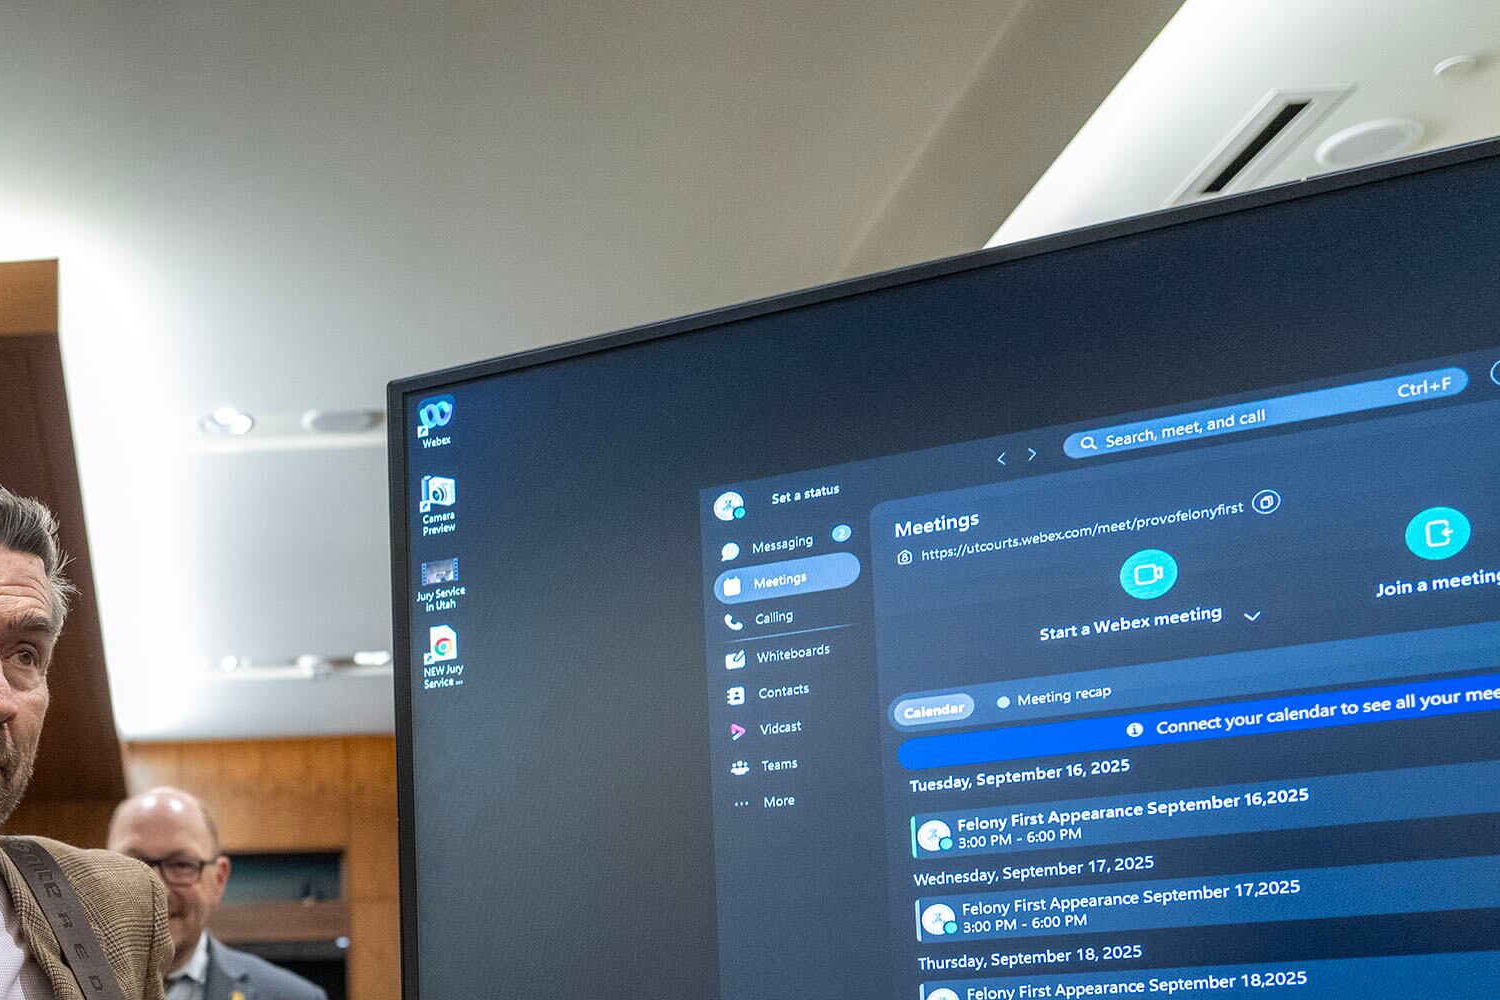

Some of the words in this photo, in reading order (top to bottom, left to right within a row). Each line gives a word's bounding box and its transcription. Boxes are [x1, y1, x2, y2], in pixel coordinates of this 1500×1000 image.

[1398, 376, 1451, 397] Ctrl+F
[1105, 428, 1157, 449] Search,
[1162, 421, 1203, 438] meet,
[1207, 414, 1235, 430] and
[1239, 409, 1265, 427] call
[423, 436, 451, 448] Webex
[772, 492, 791, 504] Set
[794, 492, 801, 501] a
[804, 486, 839, 499] status
[423, 512, 455, 524] Camera
[895, 514, 979, 537] Meetings
[423, 523, 455, 536] Preview
[838, 529, 845, 539] 2
[922, 501, 1244, 562] https://utcourts.webex.com/meet/provofelonyfirst
[753, 536, 813, 553] Messaging
[754, 572, 807, 589] Meetings
[1376, 580, 1412, 597] Join
[1417, 581, 1427, 591] a
[417, 592, 434, 602] Jury
[436, 586, 465, 599] Service
[426, 602, 434, 612] in
[436, 599, 456, 610] Utah
[756, 611, 793, 624] Calling
[1040, 626, 1077, 640] Start
[1081, 626, 1090, 635] a
[1093, 617, 1150, 633] Webex
[1154, 607, 1222, 626] meeting
[757, 644, 830, 663] Whiteboards
[424, 665, 445, 677] NEW
[446, 664, 464, 675] Jury
[424, 677, 454, 689] Service
[759, 684, 809, 699] Contacts
[1018, 691, 1071, 706] Meeting
[1076, 688, 1111, 699] recap
[904, 702, 965, 719] Calendar
[1157, 717, 1222, 734] Connect
[1225, 714, 1263, 731] your
[1267, 704, 1337, 722] calendar
[1340, 703, 1359, 715] to
[1363, 700, 1391, 712] see
[1396, 694, 1415, 709] all
[1420, 693, 1461, 711] your
[760, 721, 801, 735] Vidcast
[762, 760, 797, 771] Teams
[910, 776, 972, 792] Tuesday,
[977, 767, 1062, 787] September
[1066, 764, 1086, 777] 16,
[1091, 759, 1130, 774] 2025
[764, 796, 795, 808] More
[958, 817, 1007, 832] Felony
[1012, 813, 1044, 827] First
[1047, 806, 1143, 826] Appearance
[1147, 795, 1240, 816] September
[959, 836, 986, 849] 3:00
[991, 833, 1011, 846] PM
[1027, 830, 1055, 843] 6:00
[1060, 827, 1081, 840] PM
[914, 869, 999, 886] Wednesday,
[1003, 862, 1083, 881] September
[1089, 859, 1111, 873] 17,
[1115, 856, 1154, 871] 2025
[963, 902, 1010, 916] Felony
[1015, 898, 1046, 912] First
[1049, 894, 1139, 911] Appearance
[1143, 885, 1230, 905] September
[964, 920, 991, 933] 3:00
[995, 919, 1016, 931] PM
[1032, 916, 1061, 928] 6:00
[1065, 913, 1087, 926] PM
[918, 955, 987, 970] Thursday,
[991, 950, 1071, 968] September
[1077, 948, 1098, 961] 18,
[1103, 945, 1142, 959] 2025
[1019, 984, 1052, 998] First
[1055, 982, 1145, 999] Appearance
[1149, 975, 1236, 994] September
